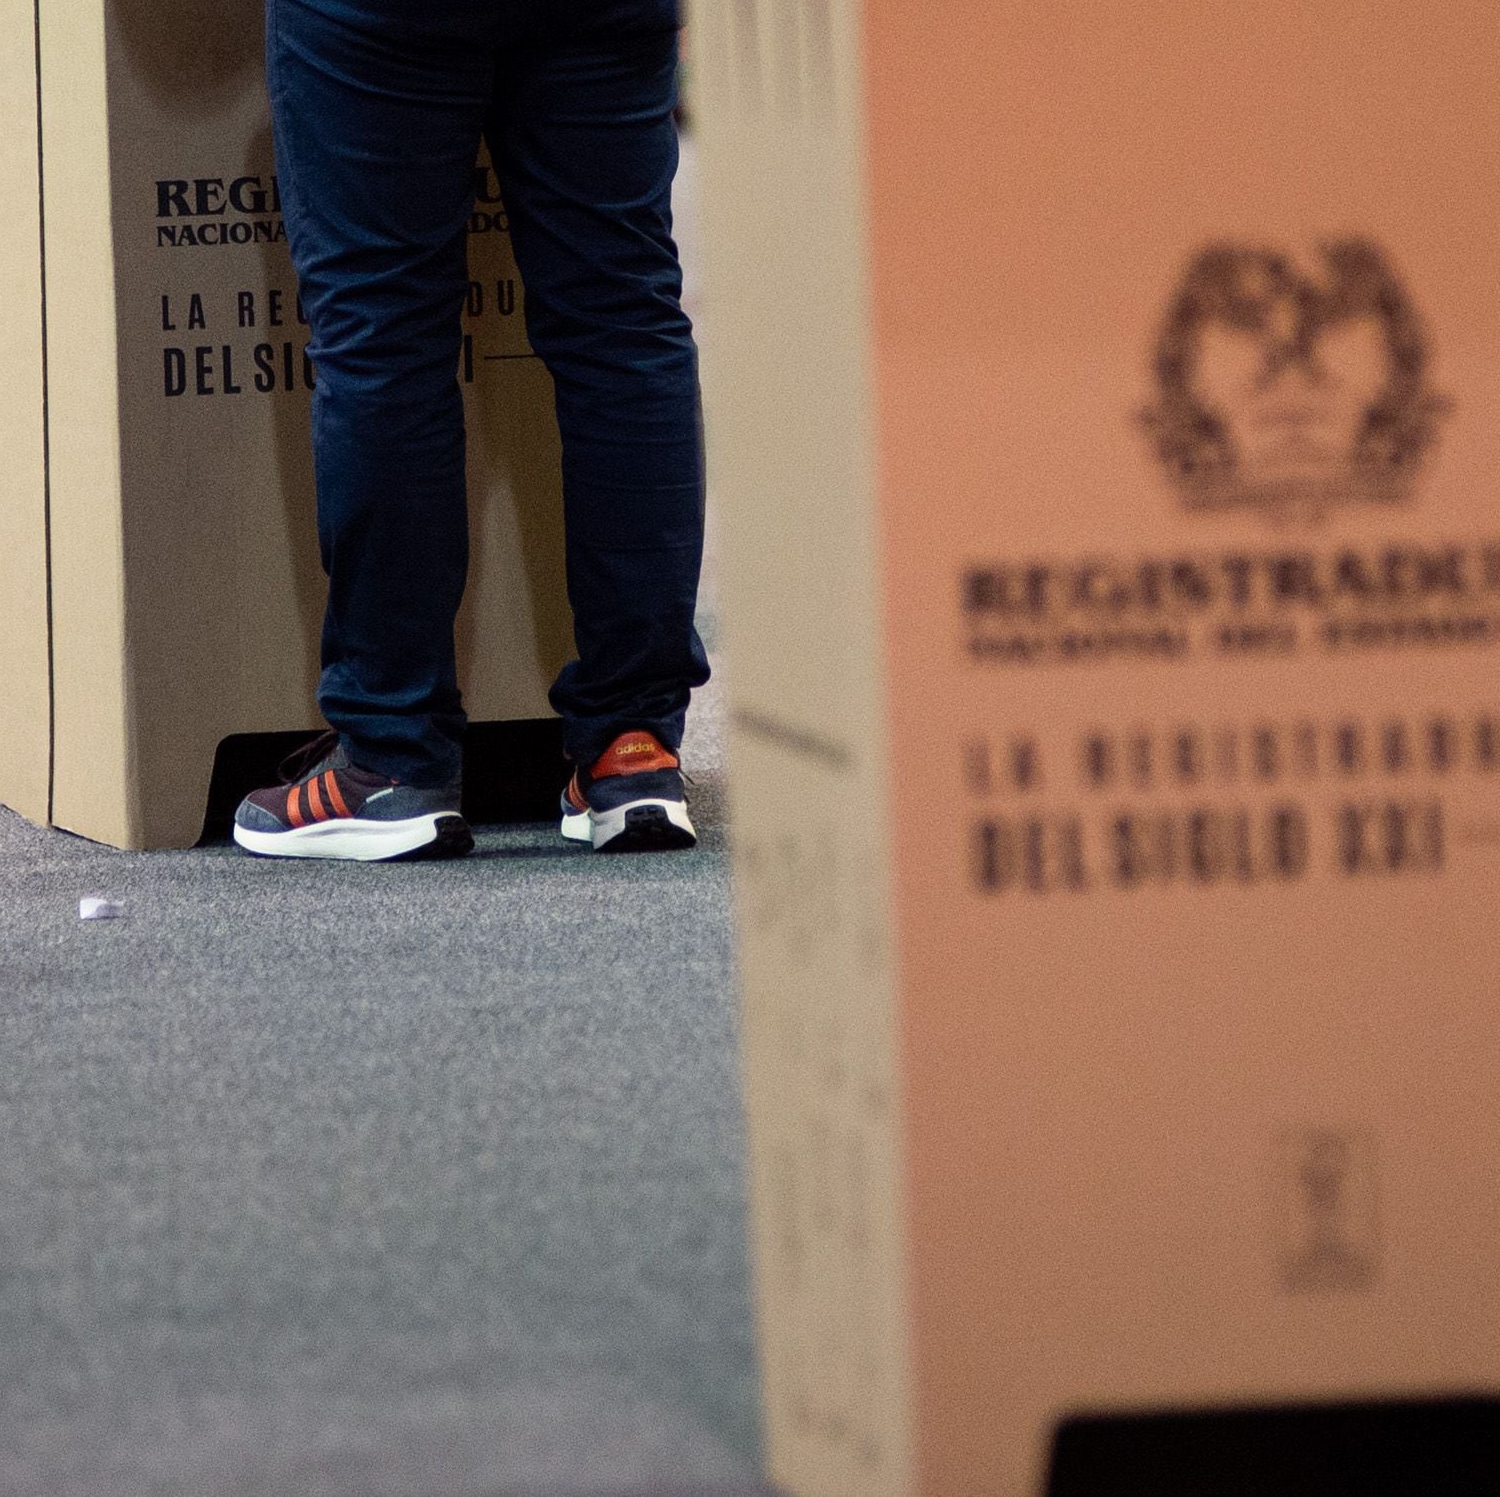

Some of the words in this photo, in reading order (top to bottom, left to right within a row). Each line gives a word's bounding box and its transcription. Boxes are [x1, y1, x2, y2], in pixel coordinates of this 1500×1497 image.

[154, 174, 283, 218] REGI
[156, 219, 288, 248] NACIONA
[161, 293, 207, 331] LA
[615, 743, 656, 755] adidas
